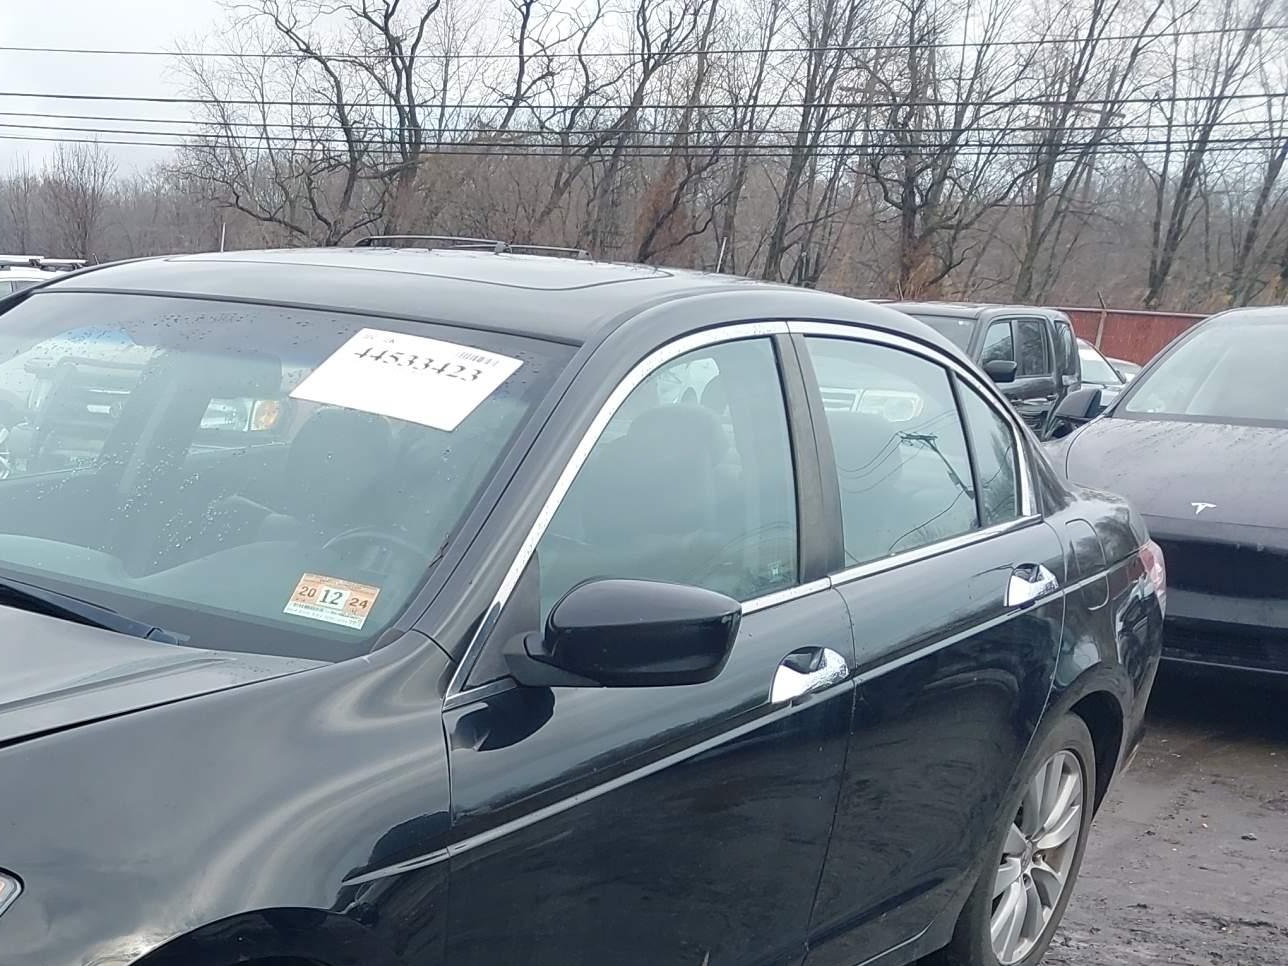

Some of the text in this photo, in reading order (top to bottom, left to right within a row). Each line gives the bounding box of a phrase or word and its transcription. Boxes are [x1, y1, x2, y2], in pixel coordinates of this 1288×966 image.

[354, 346, 483, 382] 44533423
[298, 585, 368, 609] 20 12 24
